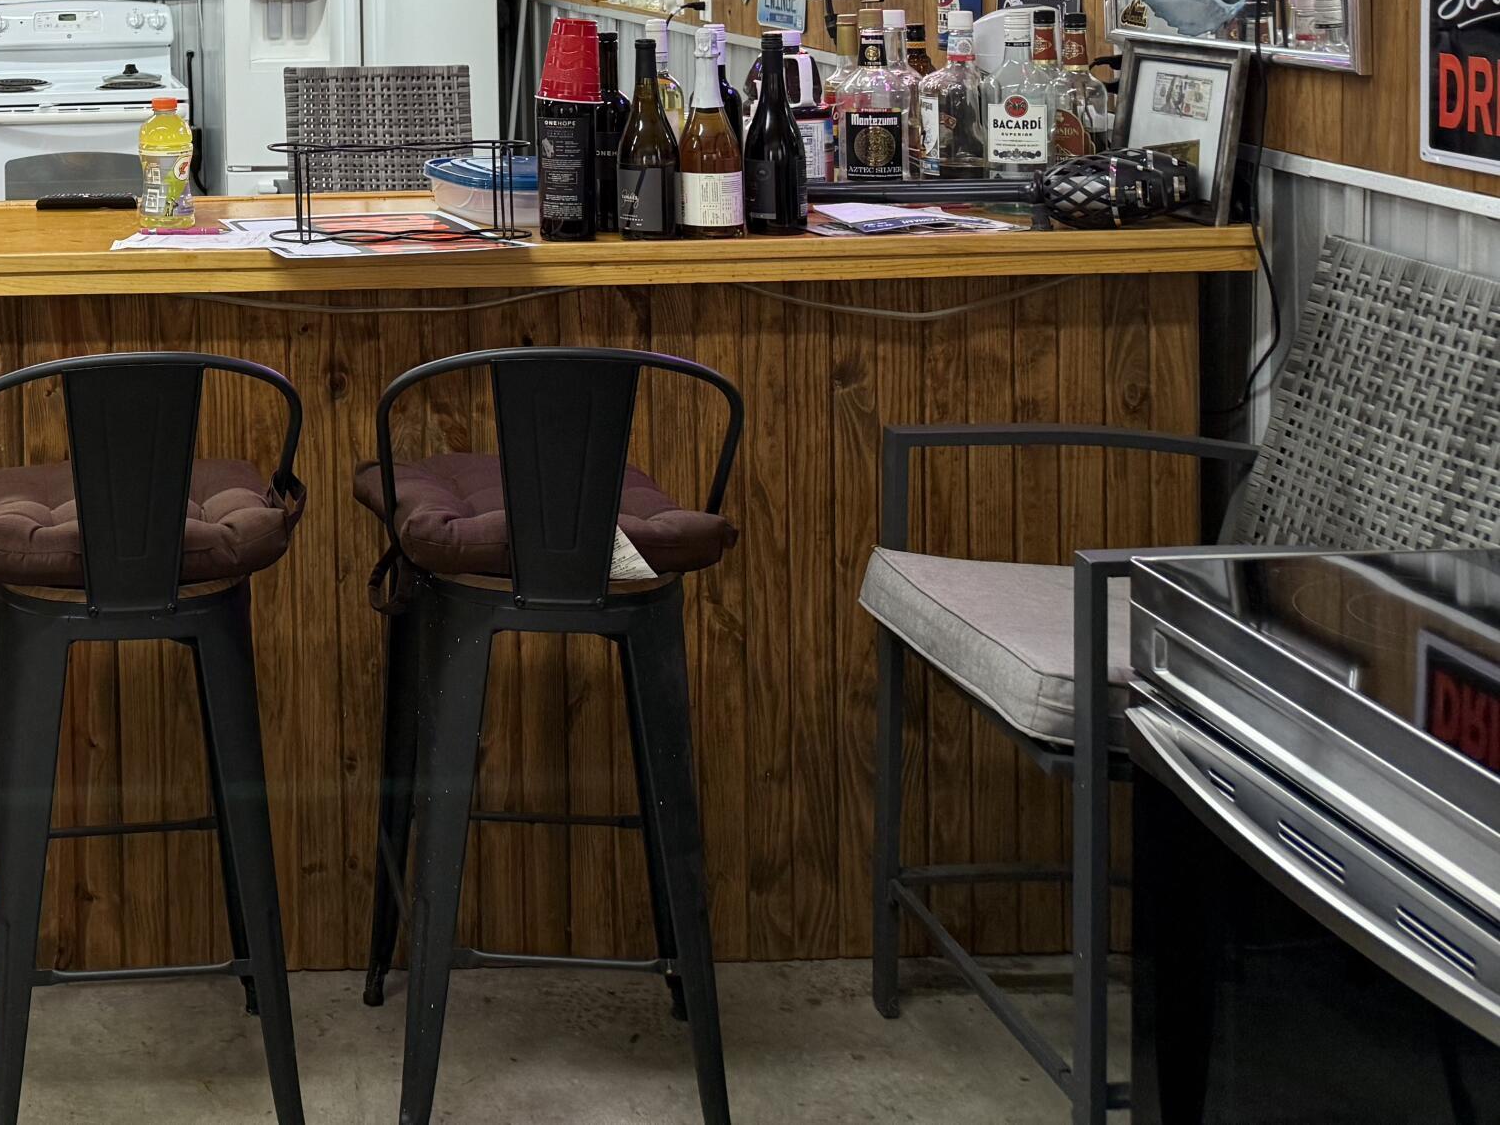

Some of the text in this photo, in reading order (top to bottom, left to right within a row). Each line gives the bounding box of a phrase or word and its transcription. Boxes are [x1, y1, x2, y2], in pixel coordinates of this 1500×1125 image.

[851, 114, 898, 126] Montezuma
[993, 117, 1042, 130] BACARDÍ
[848, 166, 901, 174] AZTEC SILVER
